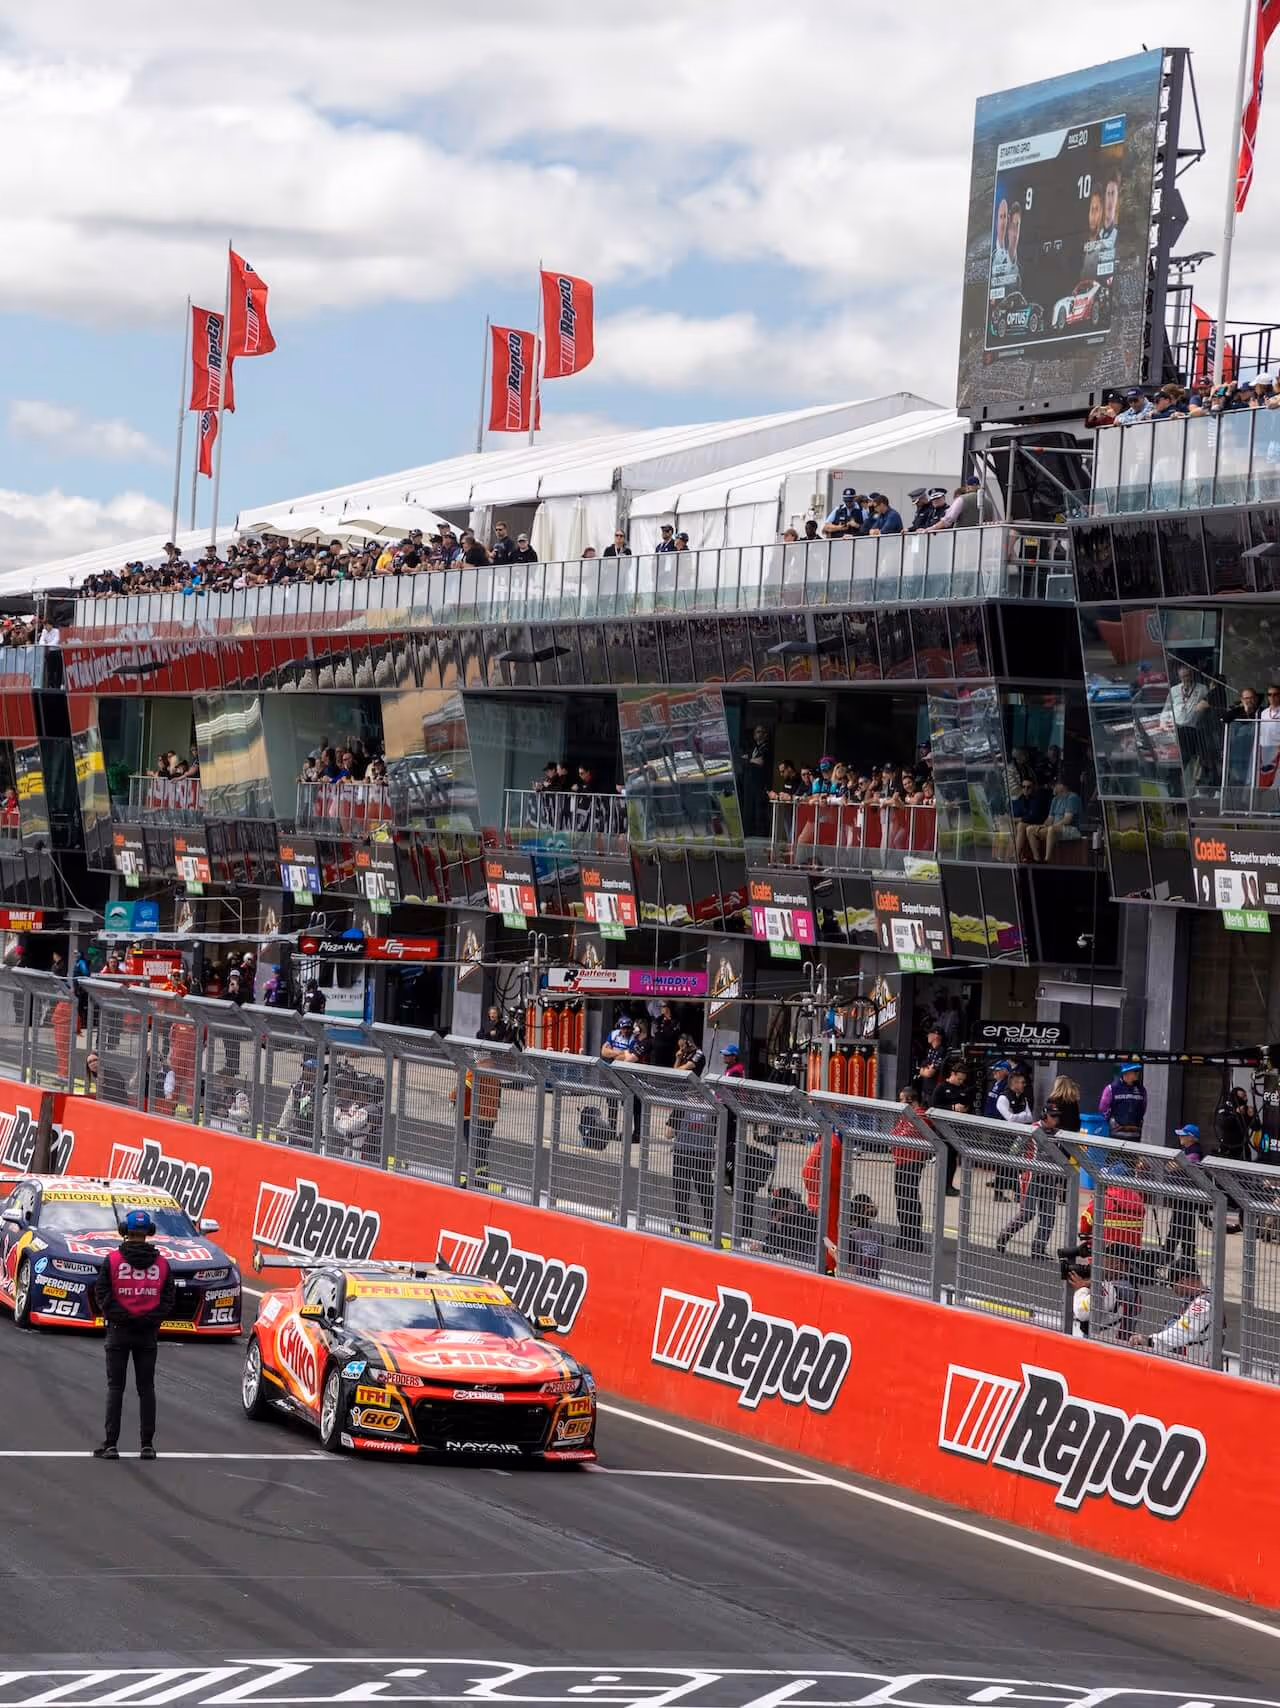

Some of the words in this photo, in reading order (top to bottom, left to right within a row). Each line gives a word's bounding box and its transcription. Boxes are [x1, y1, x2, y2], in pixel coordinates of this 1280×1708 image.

[1078, 129, 1089, 145] 20
[1077, 174, 1091, 199] 10
[1025, 187, 1033, 211] 9
[558, 276, 577, 338] Repco
[1007, 310, 1027, 326] OPTUS
[507, 331, 525, 395] Repco
[1194, 837, 1227, 861] Coates
[750, 880, 772, 901] Coates
[1202, 875, 1210, 902] 9
[875, 890, 900, 912] Coates
[8, 910, 27, 920] MAKE
[27, 911, 36, 920] IT
[754, 911, 765, 936] 14
[882, 922, 889, 947] 8
[320, 942, 343, 952] Pizza
[342, 942, 364, 953] Hut
[579, 970, 617, 978] Batteries
[983, 1023, 1060, 1039] erebus
[1004, 1037, 1058, 1045] motorsport
[134, 1139, 213, 1222] Repco
[44, 1192, 108, 1202] NATIONAL
[114, 1193, 178, 1208] STORAGE
[279, 1178, 381, 1260] Repco
[118, 1262, 160, 1281] 289
[472, 1225, 588, 1335] Repco
[34, 1274, 86, 1294] SUPERCHEAP
[45, 1287, 65, 1297] AUTO
[118, 1287, 133, 1296] PIT
[134, 1287, 158, 1297] LANE
[357, 1284, 402, 1295] TFH
[408, 1287, 452, 1299] TFH
[459, 1289, 504, 1301] TFH
[42, 1299, 81, 1317] JGI
[445, 1300, 487, 1310] Kostecki
[693, 1285, 852, 1411] Repco
[280, 1321, 317, 1398] CHIKO
[414, 1351, 538, 1371] CHIKO
[386, 1372, 422, 1386] PEDDERS
[552, 1381, 577, 1394] PEDDERS
[359, 1387, 387, 1405] TFH
[570, 1400, 590, 1414] TFH
[446, 1440, 520, 1452] NAYAIR
[992, 1363, 1208, 1519] Repco
